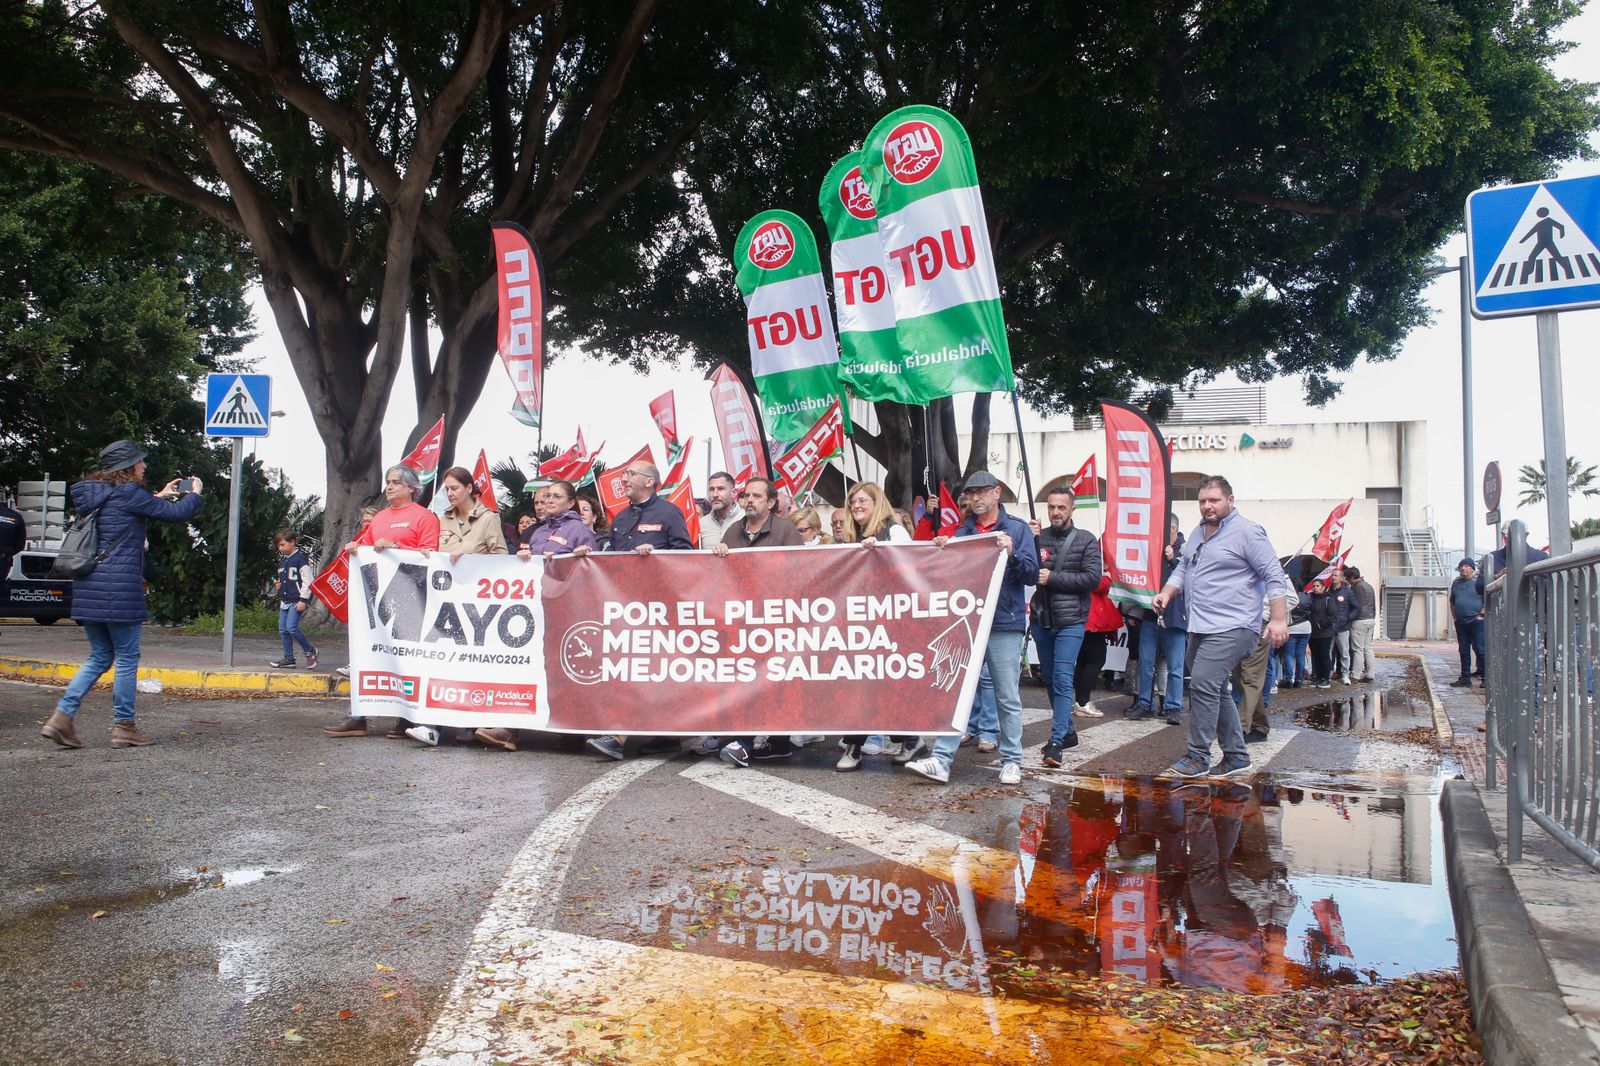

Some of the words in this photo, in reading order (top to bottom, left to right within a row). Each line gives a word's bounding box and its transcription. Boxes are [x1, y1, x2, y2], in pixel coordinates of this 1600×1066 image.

[1165, 434, 1228, 450] ECIRAS
[477, 578, 535, 600] 2024
[603, 601, 669, 627] POR
[676, 601, 717, 627] EL
[724, 598, 836, 626] PLENO
[846, 589, 985, 621] EMPLEO:
[602, 629, 721, 656] MENOS
[729, 625, 899, 654] JORNADA,
[458, 653, 531, 665] #1MAYO2024
[602, 656, 758, 683] MEJORES
[766, 652, 925, 682] SALARIOS
[431, 686, 470, 704] UGT
[495, 690, 533, 701] Andalucía
